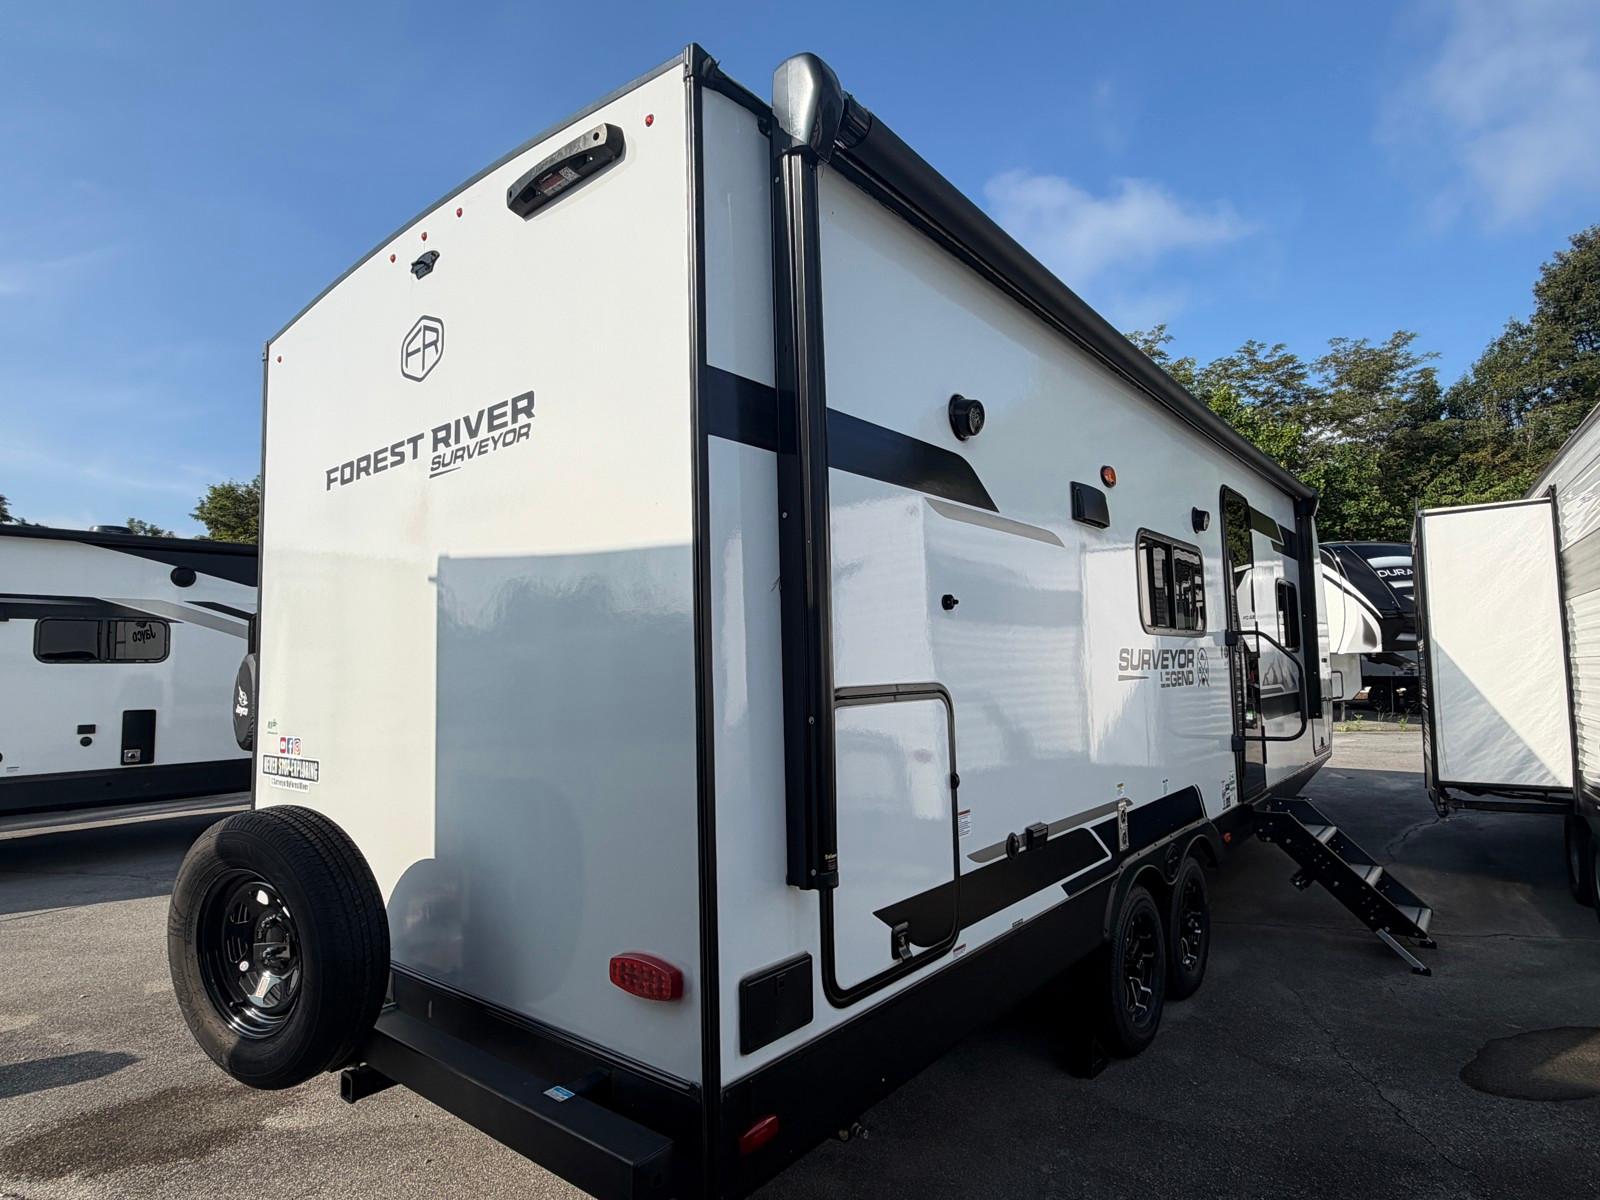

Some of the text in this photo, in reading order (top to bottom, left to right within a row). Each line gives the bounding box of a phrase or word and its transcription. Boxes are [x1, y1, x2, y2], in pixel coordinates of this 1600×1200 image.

[325, 390, 536, 491] FOREST RIVER
[430, 422, 532, 472] SURVEYOR
[1118, 648, 1195, 671] SURVEYOR
[1160, 670, 1194, 688] LEGEND
